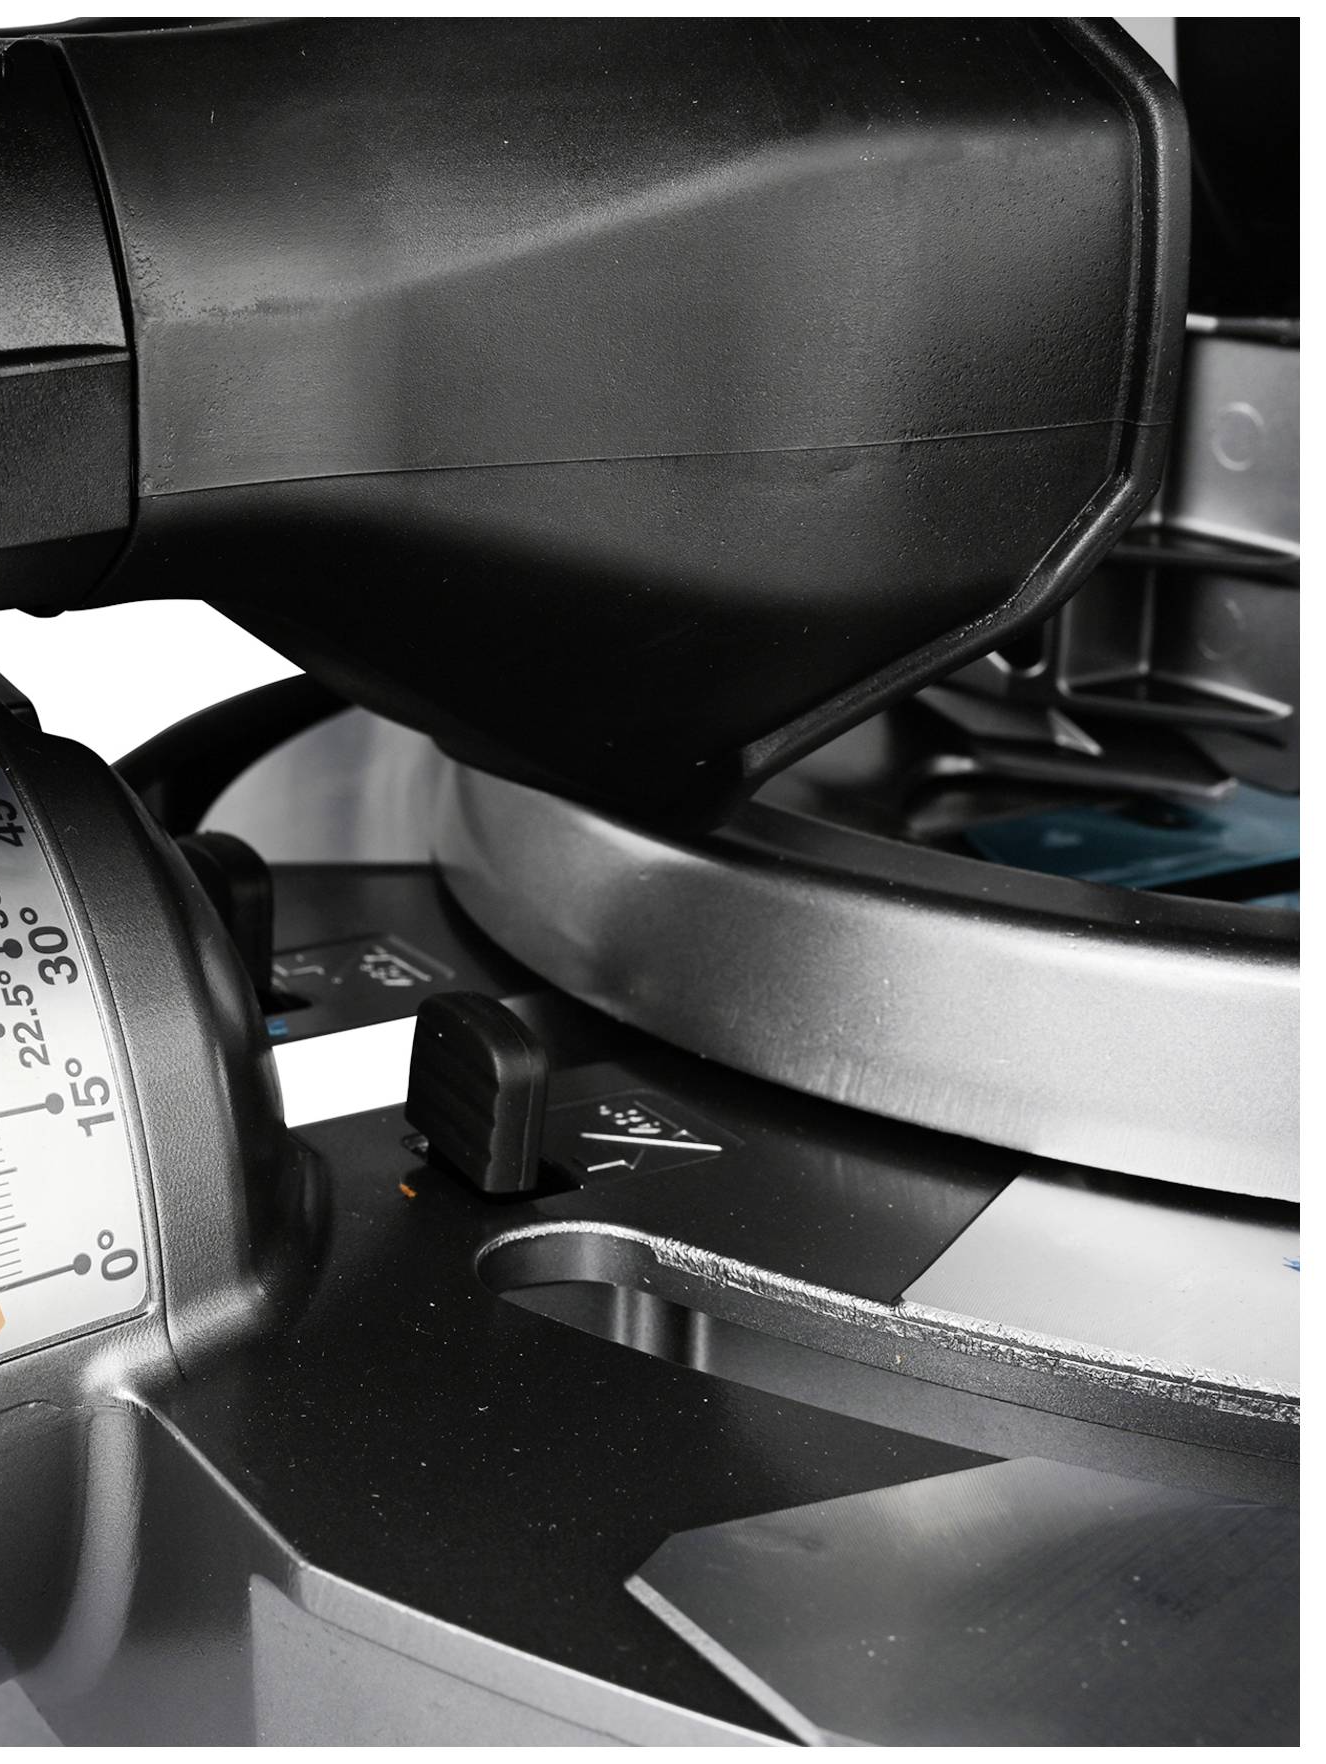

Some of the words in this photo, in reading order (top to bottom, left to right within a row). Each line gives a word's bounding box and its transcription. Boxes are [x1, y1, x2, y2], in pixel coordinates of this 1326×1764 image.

[20, 907, 78, 985] 30°
[65, 1058, 115, 1137] 15°
[97, 1229, 139, 1281] 0°
